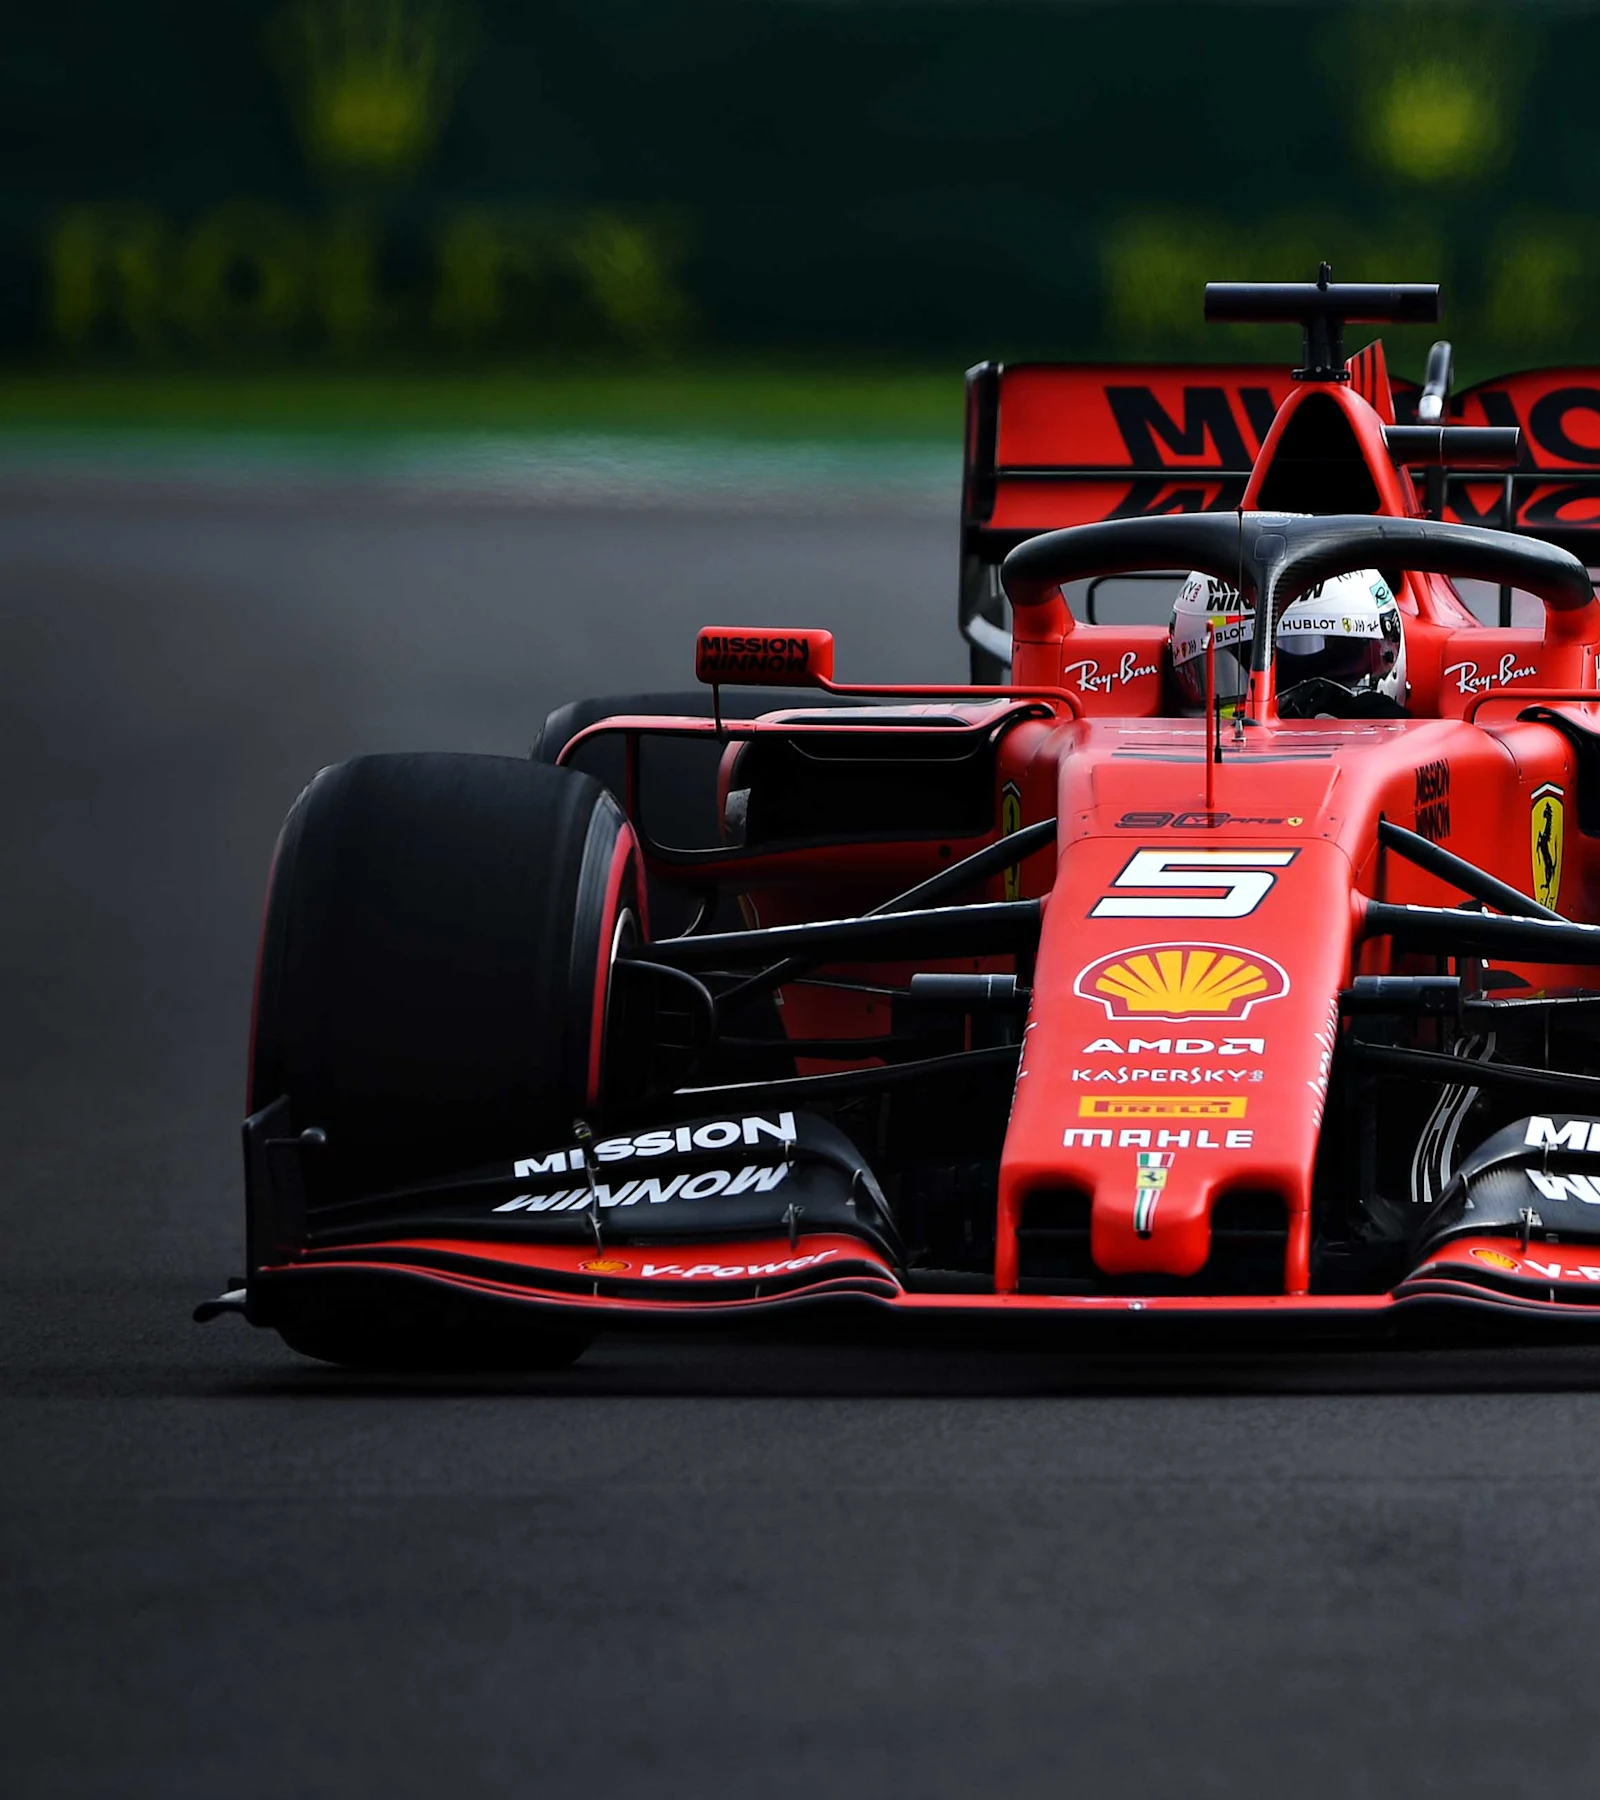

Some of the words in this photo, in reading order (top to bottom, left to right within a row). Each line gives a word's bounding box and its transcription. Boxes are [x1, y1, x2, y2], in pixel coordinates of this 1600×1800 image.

[1282, 619, 1336, 631] HUBLOT
[701, 636, 808, 655] MISSION
[1065, 651, 1157, 693] Ray-Ban
[1444, 653, 1537, 693] Ray-Ban
[1087, 847, 1302, 918] 5
[1083, 1038, 1215, 1055] AMD
[1072, 1066, 1248, 1084] KASPERSKY
[514, 1111, 797, 1178] MISSION
[1062, 1128, 1254, 1148] MAHLE
[491, 1161, 795, 1212] WINNOW
[640, 1249, 837, 1278] V-Power
